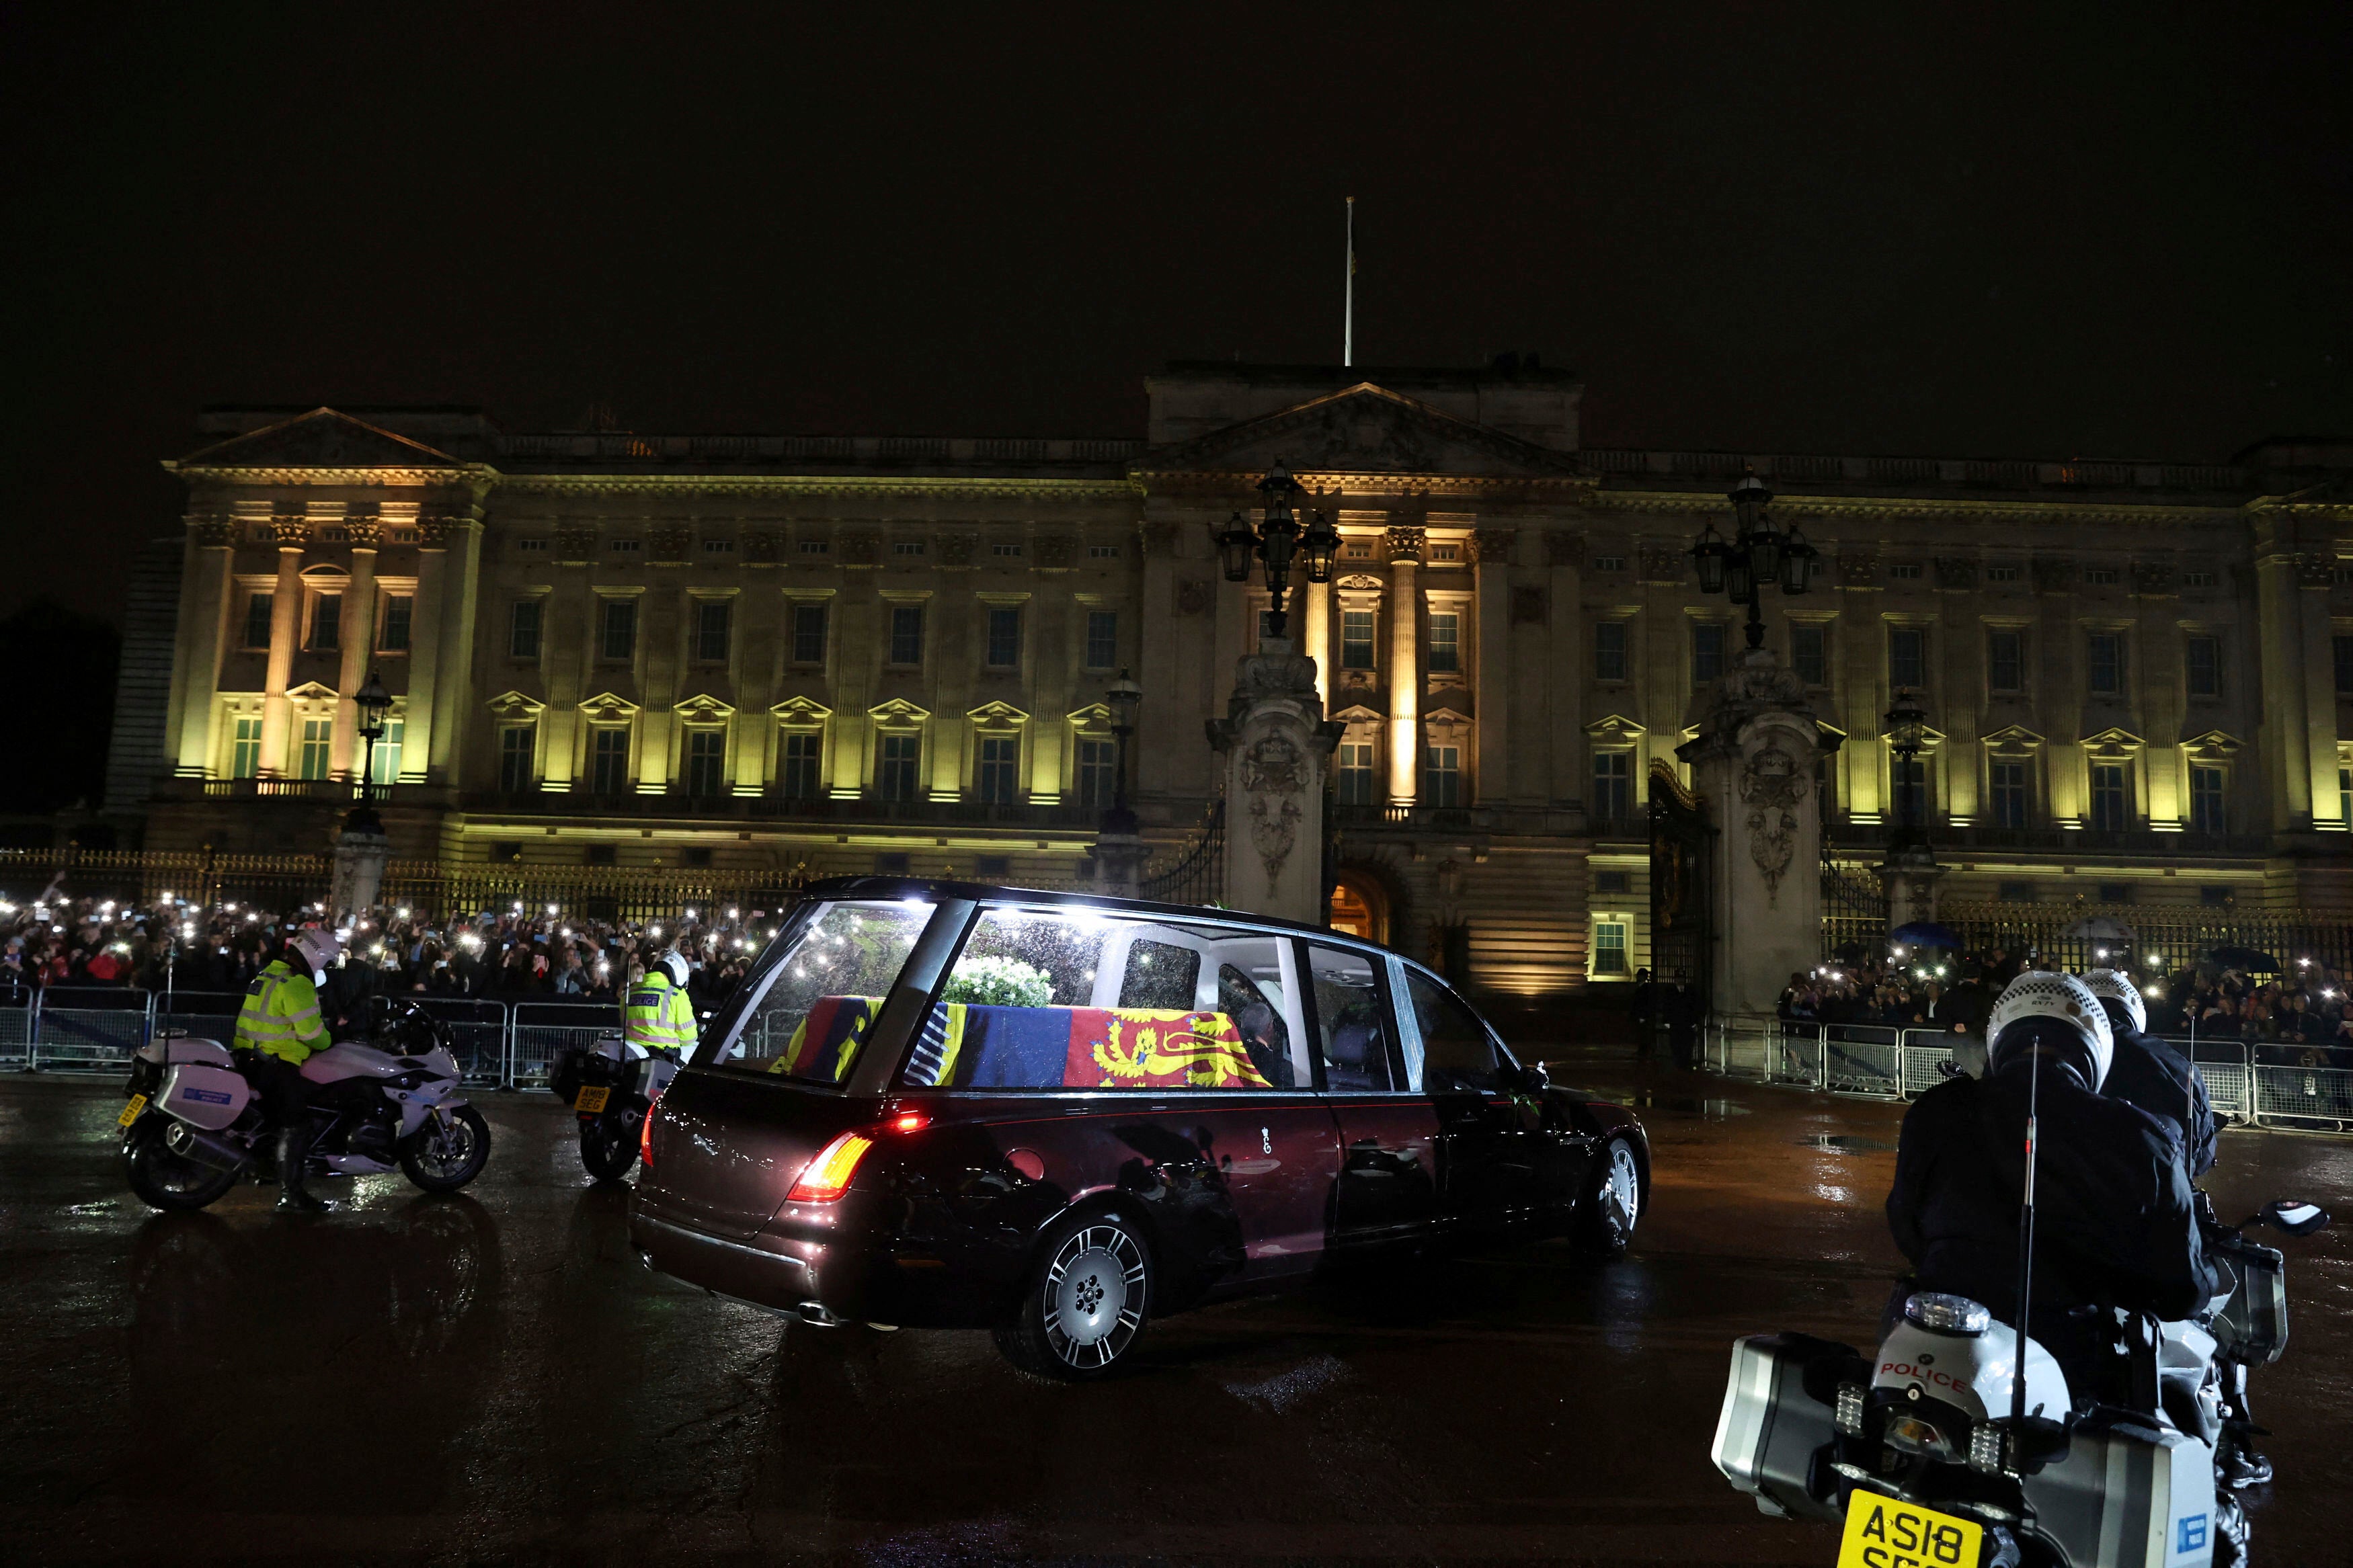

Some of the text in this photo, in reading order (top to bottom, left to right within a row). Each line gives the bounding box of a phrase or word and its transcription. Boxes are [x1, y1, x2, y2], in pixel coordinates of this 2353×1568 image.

[580, 1099, 600, 1109] SEG
[582, 1089, 604, 1099] AM18
[1880, 1363, 1967, 1395] POLICE
[1861, 1504, 1963, 1565] AS18
